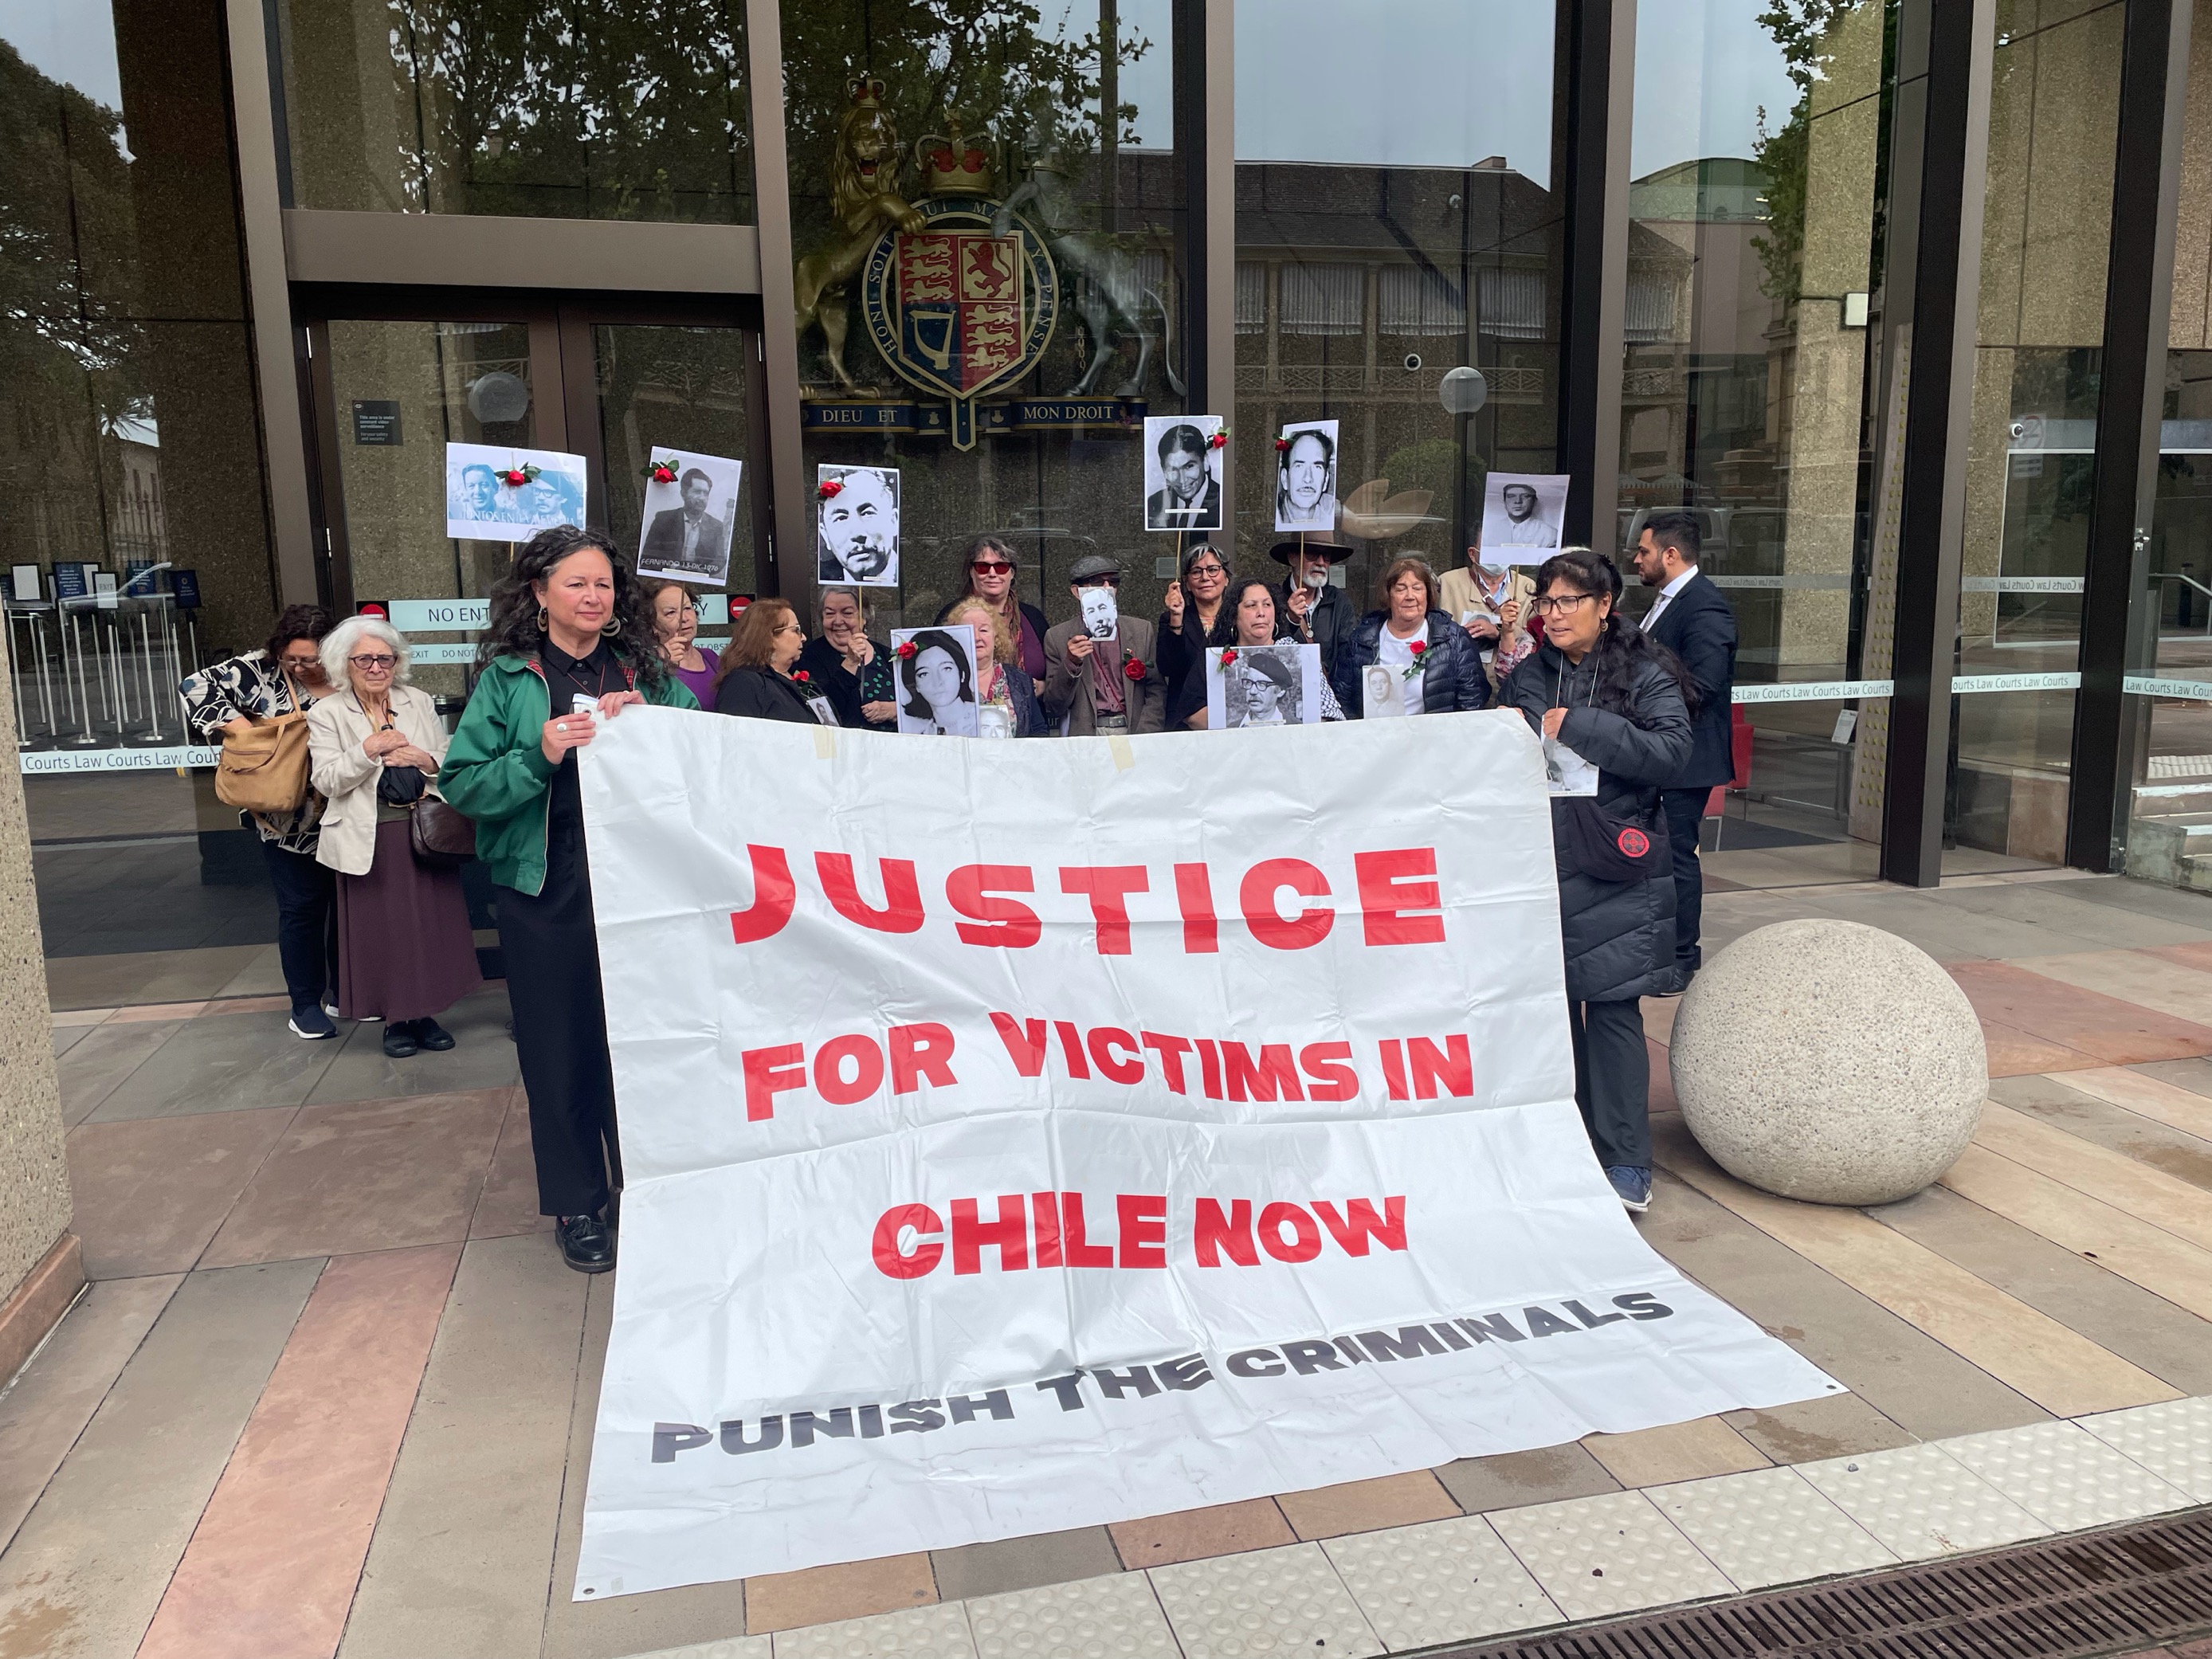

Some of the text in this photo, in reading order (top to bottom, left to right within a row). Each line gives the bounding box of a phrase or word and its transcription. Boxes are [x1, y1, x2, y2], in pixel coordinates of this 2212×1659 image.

[869, 236, 894, 284] SOIT
[869, 300, 897, 353] HONI
[1026, 284, 1053, 355] PENSE
[822, 410, 897, 422] DIEU ET
[1024, 406, 1113, 419] MON DROIT
[462, 510, 499, 522] JUNTOS
[500, 512, 517, 524] EN
[641, 558, 680, 567] FERNANDO
[428, 608, 490, 622] NO ENT
[1743, 689, 1759, 700] Law
[1763, 688, 1790, 699] Courts
[1793, 687, 1810, 697] Law
[1812, 686, 1840, 696] Courts
[1843, 684, 1860, 696] Law
[1862, 684, 1889, 695] Courts
[1953, 676, 2068, 690] ourts Law Courts Law Courts
[2126, 680, 2212, 697] Law Courts Law Cour
[25, 756, 70, 771] Courts
[75, 755, 102, 768] Law
[107, 753, 151, 767] Courts
[155, 751, 182, 766] Law
[730, 844, 1445, 955] JUSTICE
[741, 1012, 1473, 1121] FOR VICTIMS IN
[872, 1191, 1407, 1279] CHILE NOW
[651, 1292, 1674, 1463] PUNISH THE CRIMINALS
